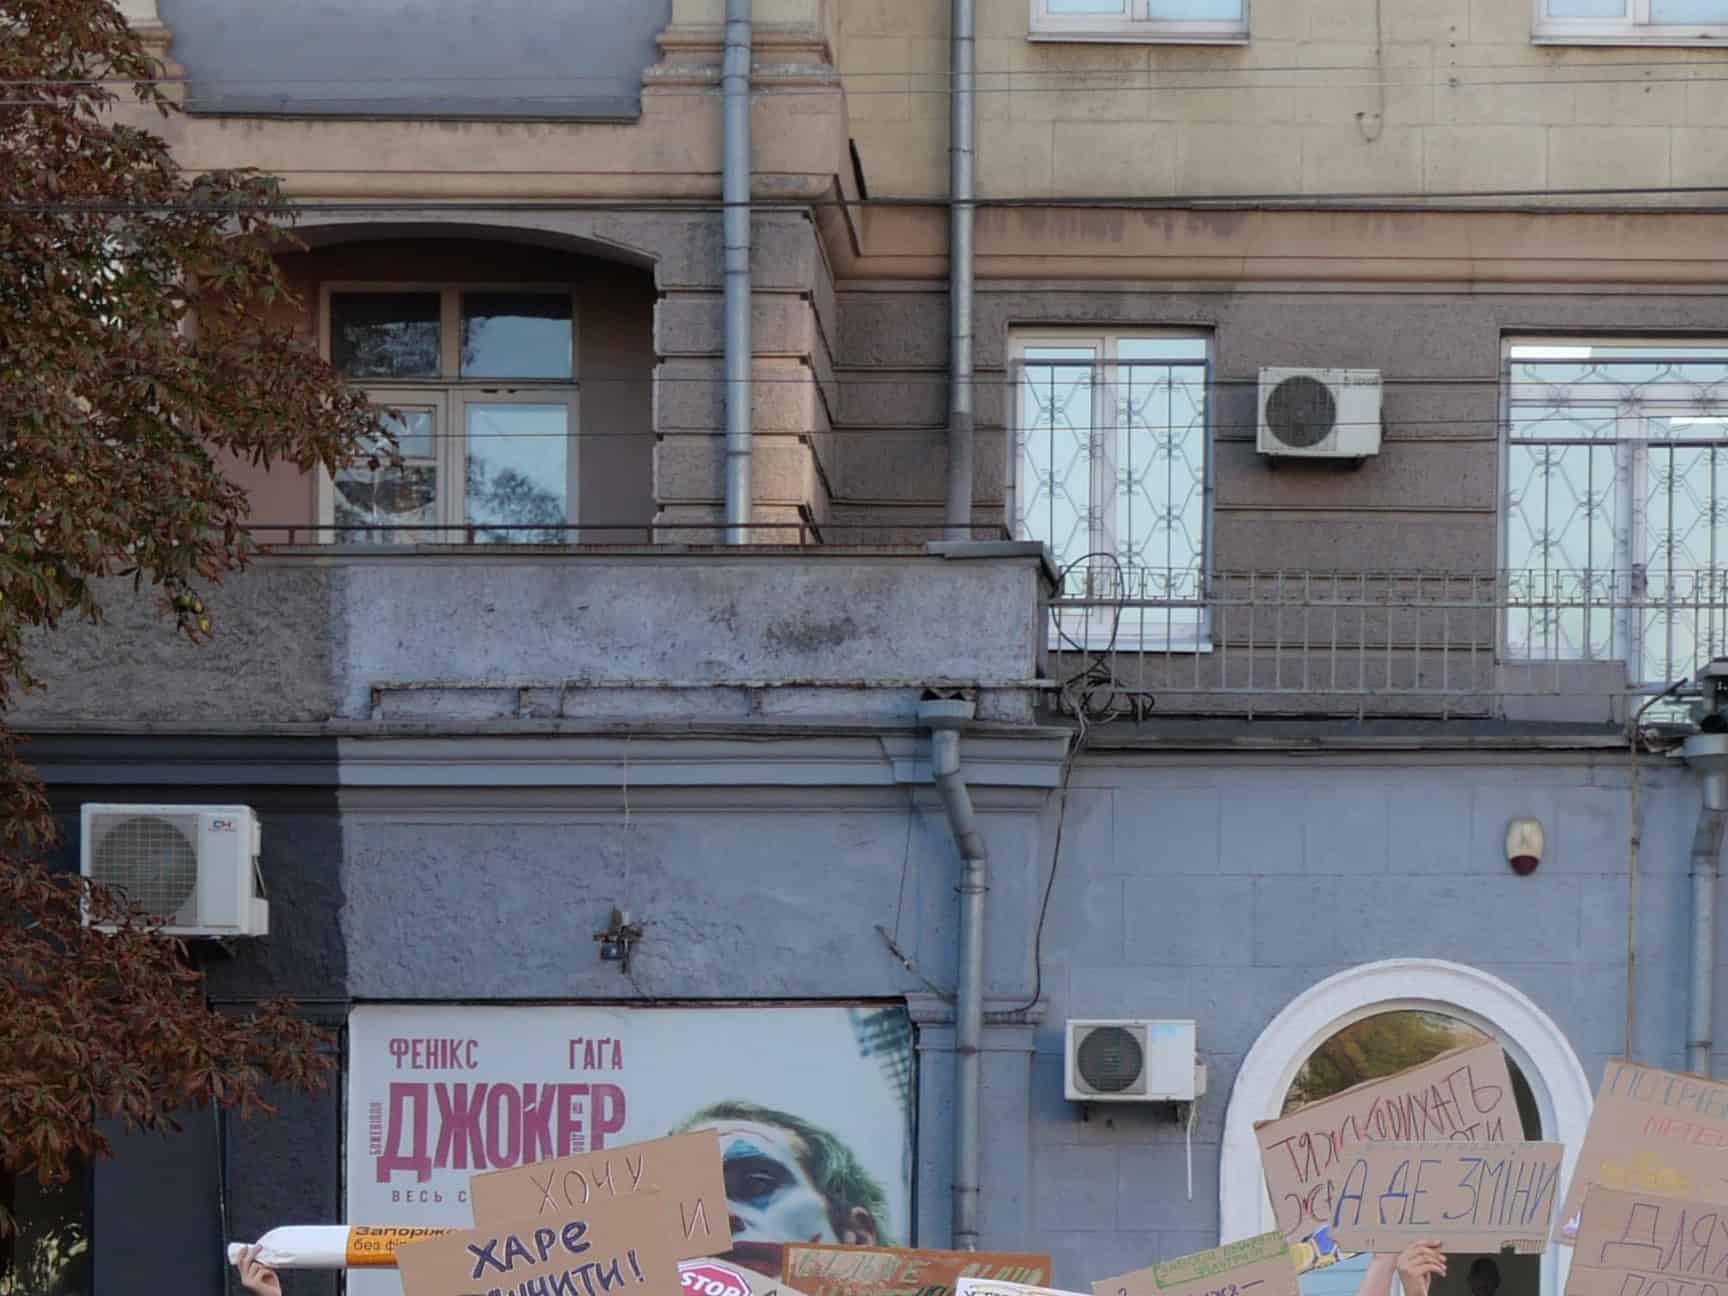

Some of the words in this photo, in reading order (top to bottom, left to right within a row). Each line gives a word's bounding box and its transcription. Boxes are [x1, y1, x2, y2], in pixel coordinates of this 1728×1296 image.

[389, 1038, 479, 1070] ФЕНІКС
[376, 1082, 626, 1183] ДЖОКЕР
[392, 1190, 443, 1203] ВЕСЬ
